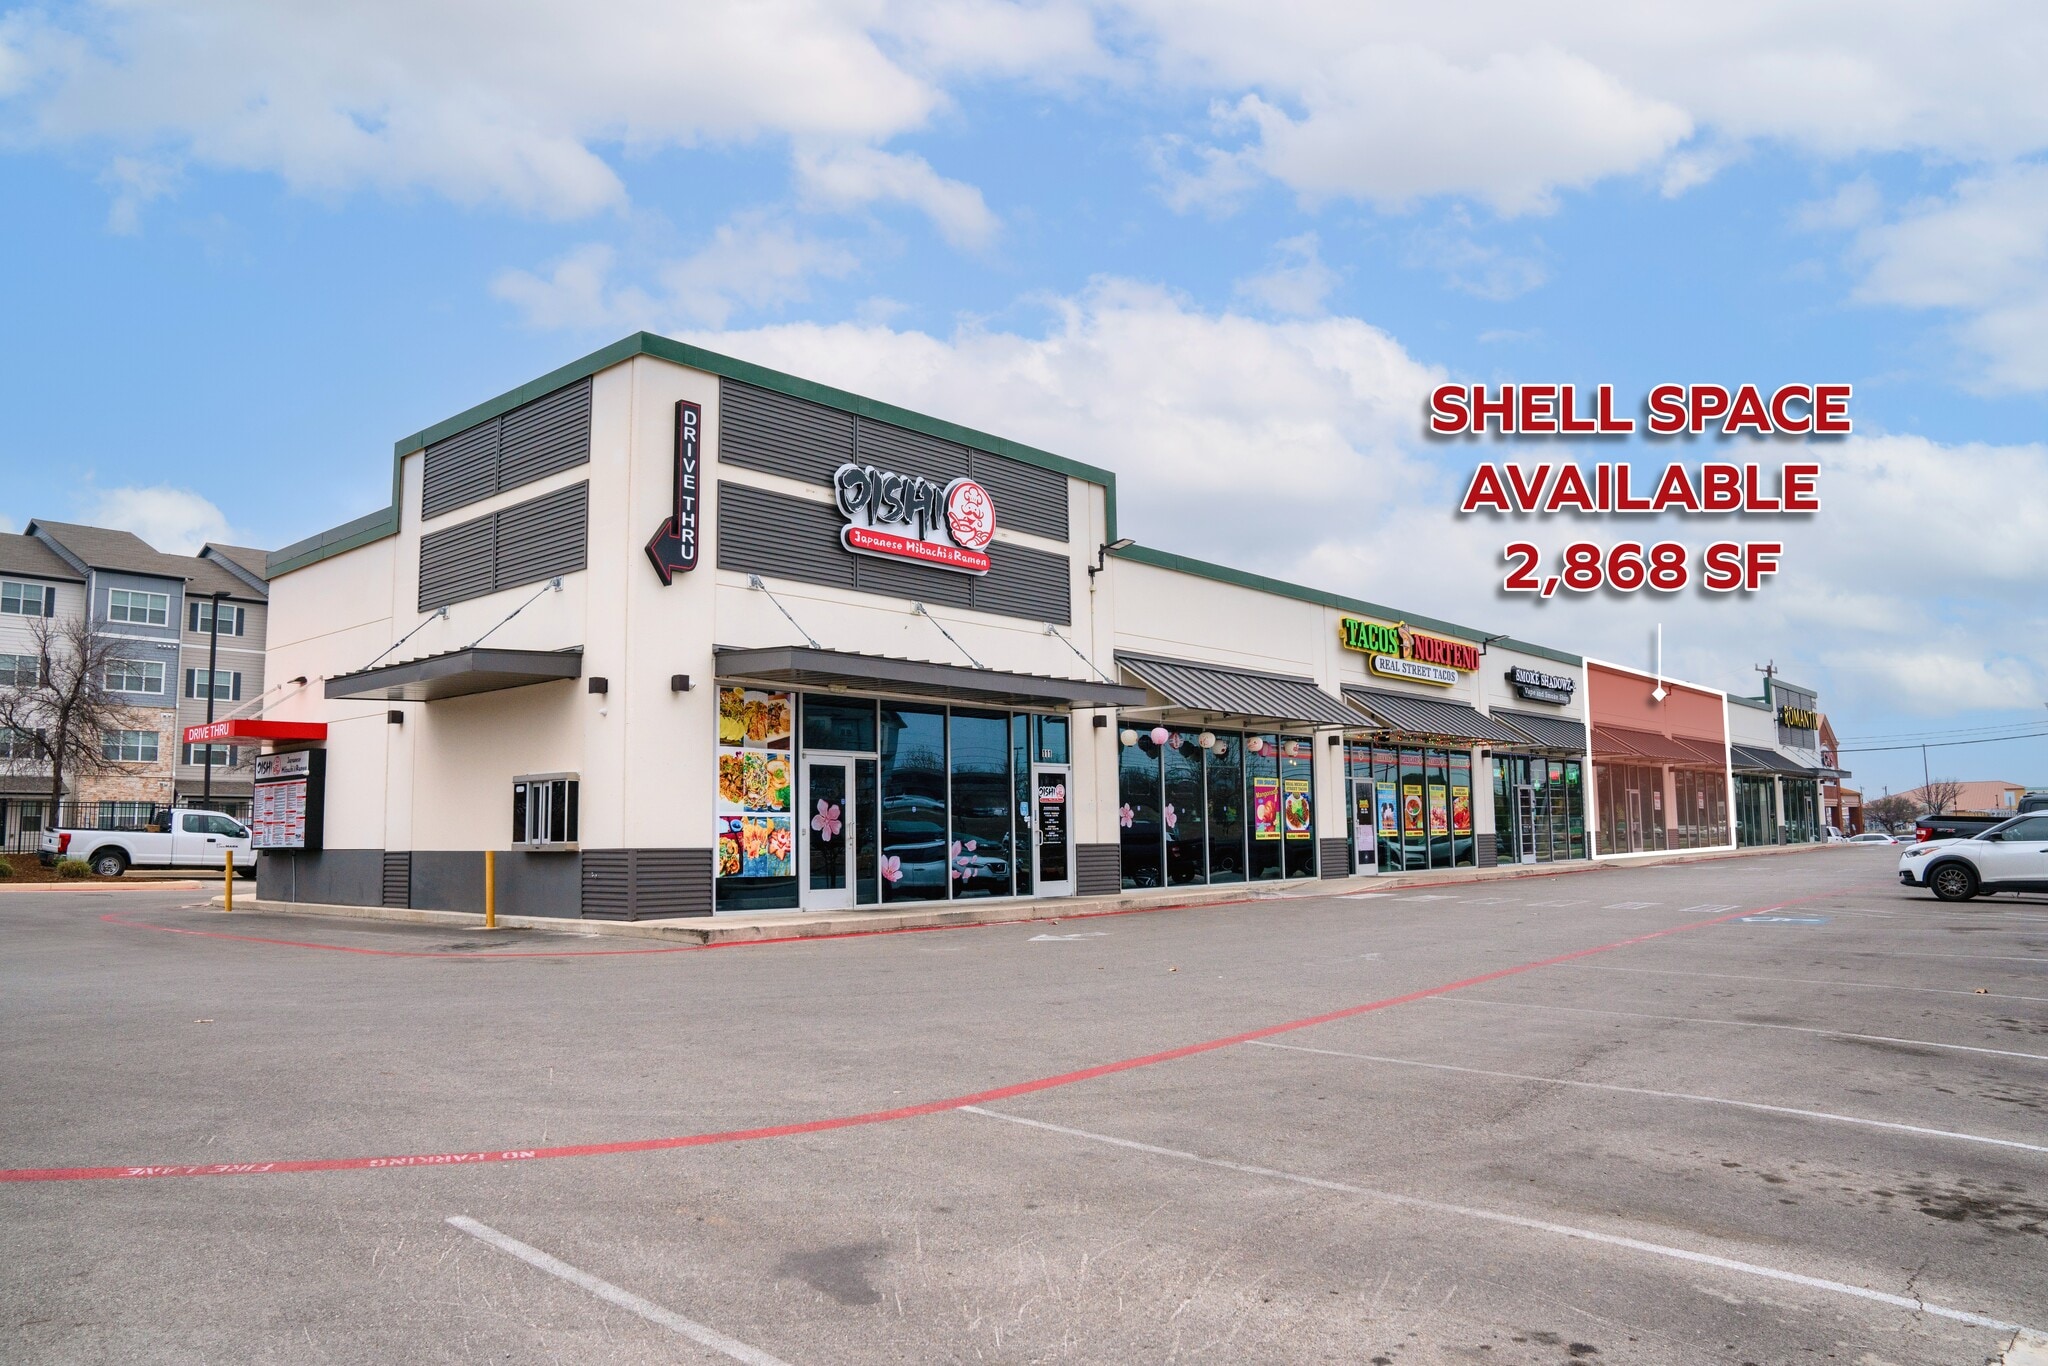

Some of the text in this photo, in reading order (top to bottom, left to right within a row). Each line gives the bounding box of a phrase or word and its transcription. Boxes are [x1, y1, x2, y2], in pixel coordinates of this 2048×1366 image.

[682, 410, 697, 489] DRIVE
[838, 468, 943, 540] OISHI
[681, 496, 696, 560] THRU
[854, 530, 903, 550] Japanese
[905, 541, 947, 558] Hibachi
[953, 551, 987, 567] Ramen
[1345, 618, 1479, 671] TACOS NORTENO
[1379, 658, 1456, 682] REAL STREET TACOS
[1515, 669, 1540, 685] SMOKE
[188, 722, 230, 741] DRIVE THRU
[1039, 786, 1056, 796] OISHI
